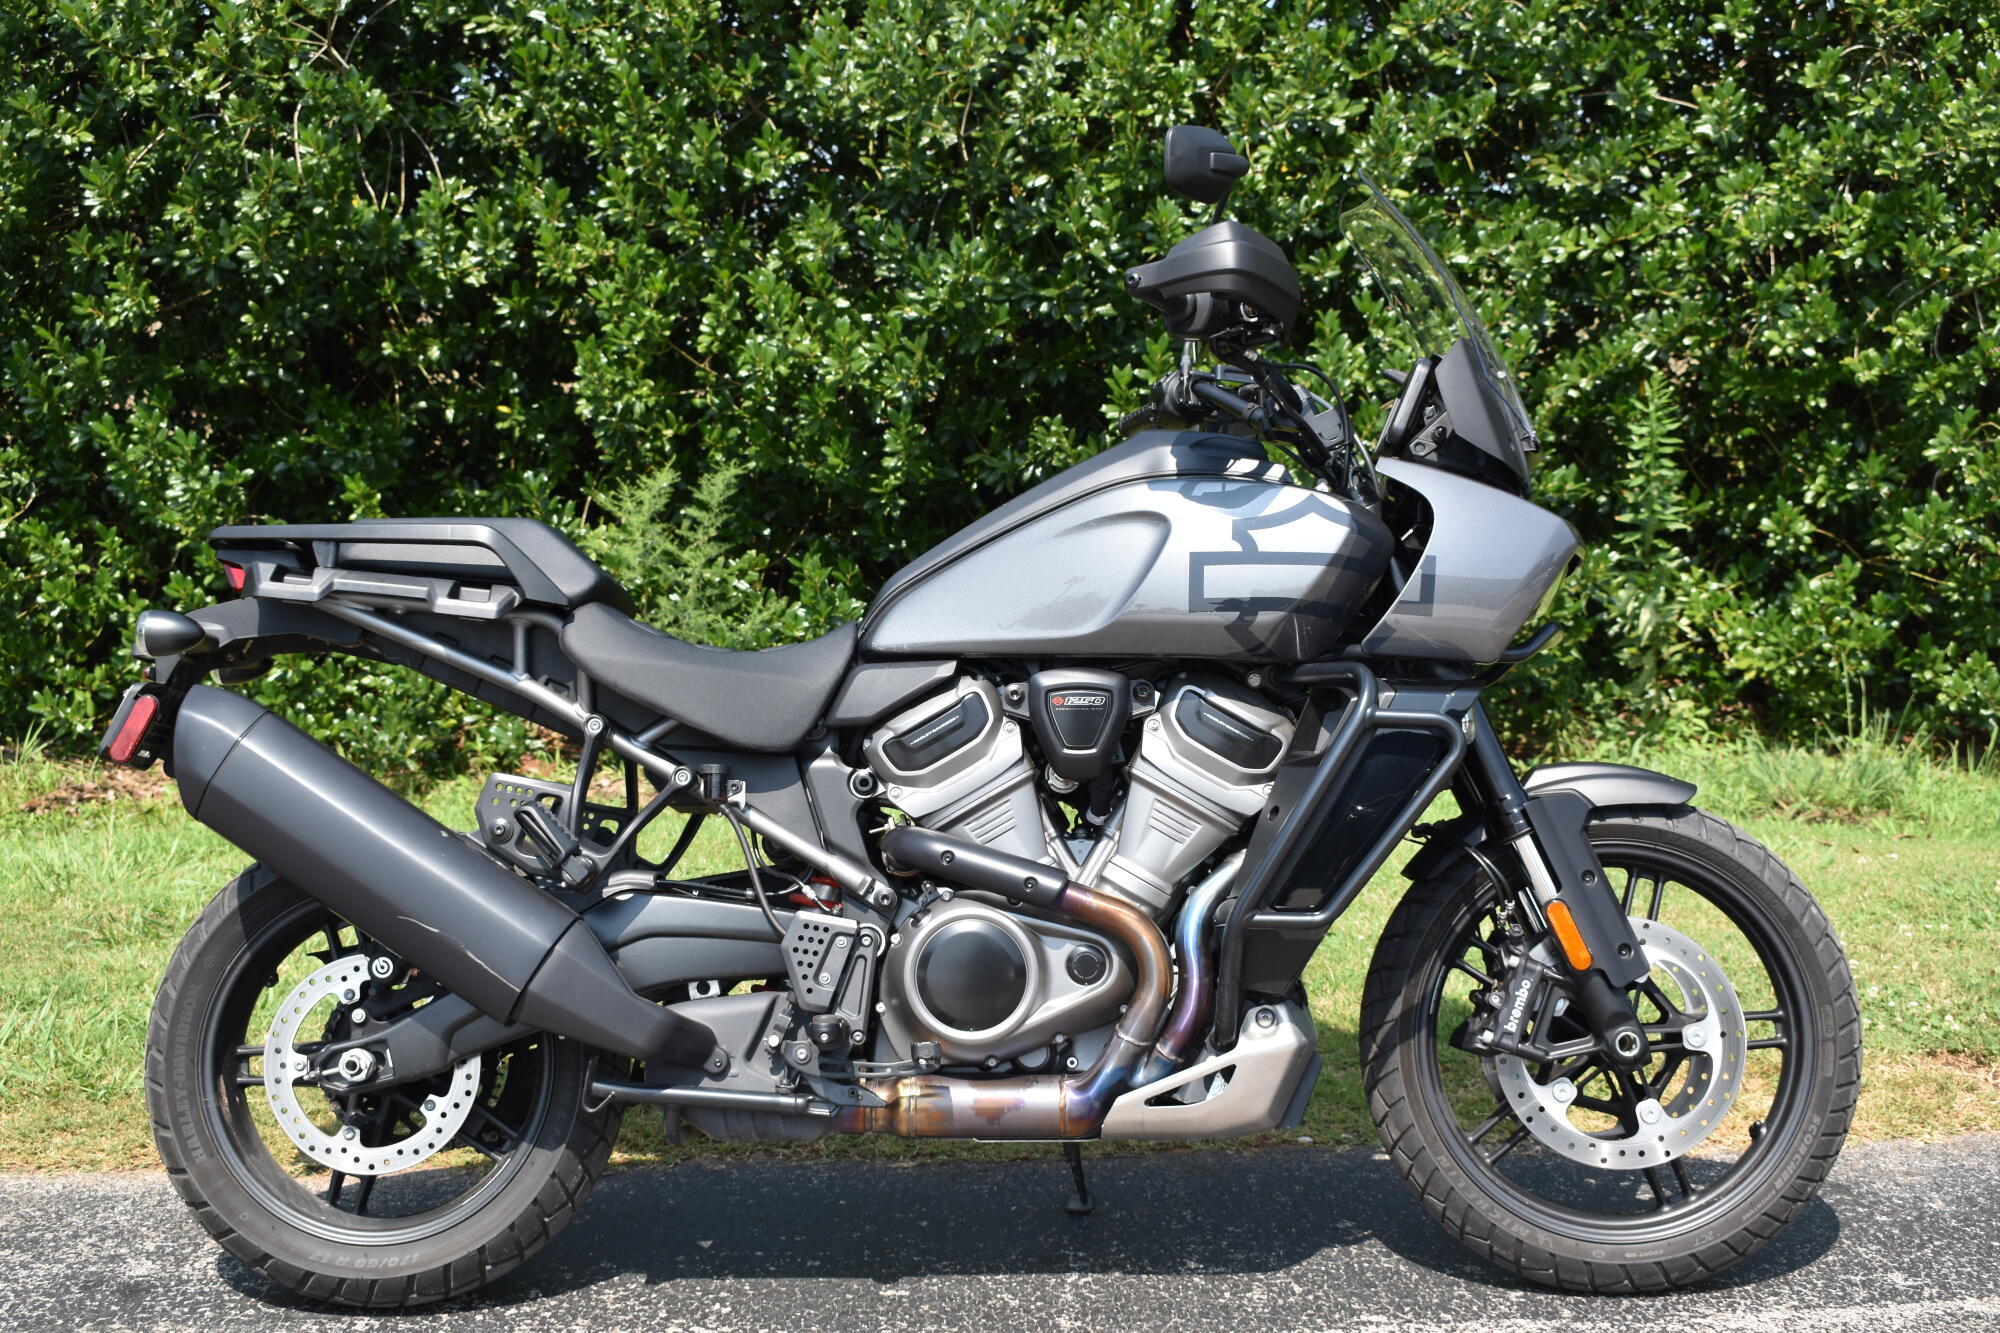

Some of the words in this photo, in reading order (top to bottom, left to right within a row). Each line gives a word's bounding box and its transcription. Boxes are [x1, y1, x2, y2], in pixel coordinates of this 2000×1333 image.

[1064, 696, 1105, 706] 1250
[1503, 979, 1531, 1032] brembo
[1436, 1155, 1533, 1236] MICHELIN
